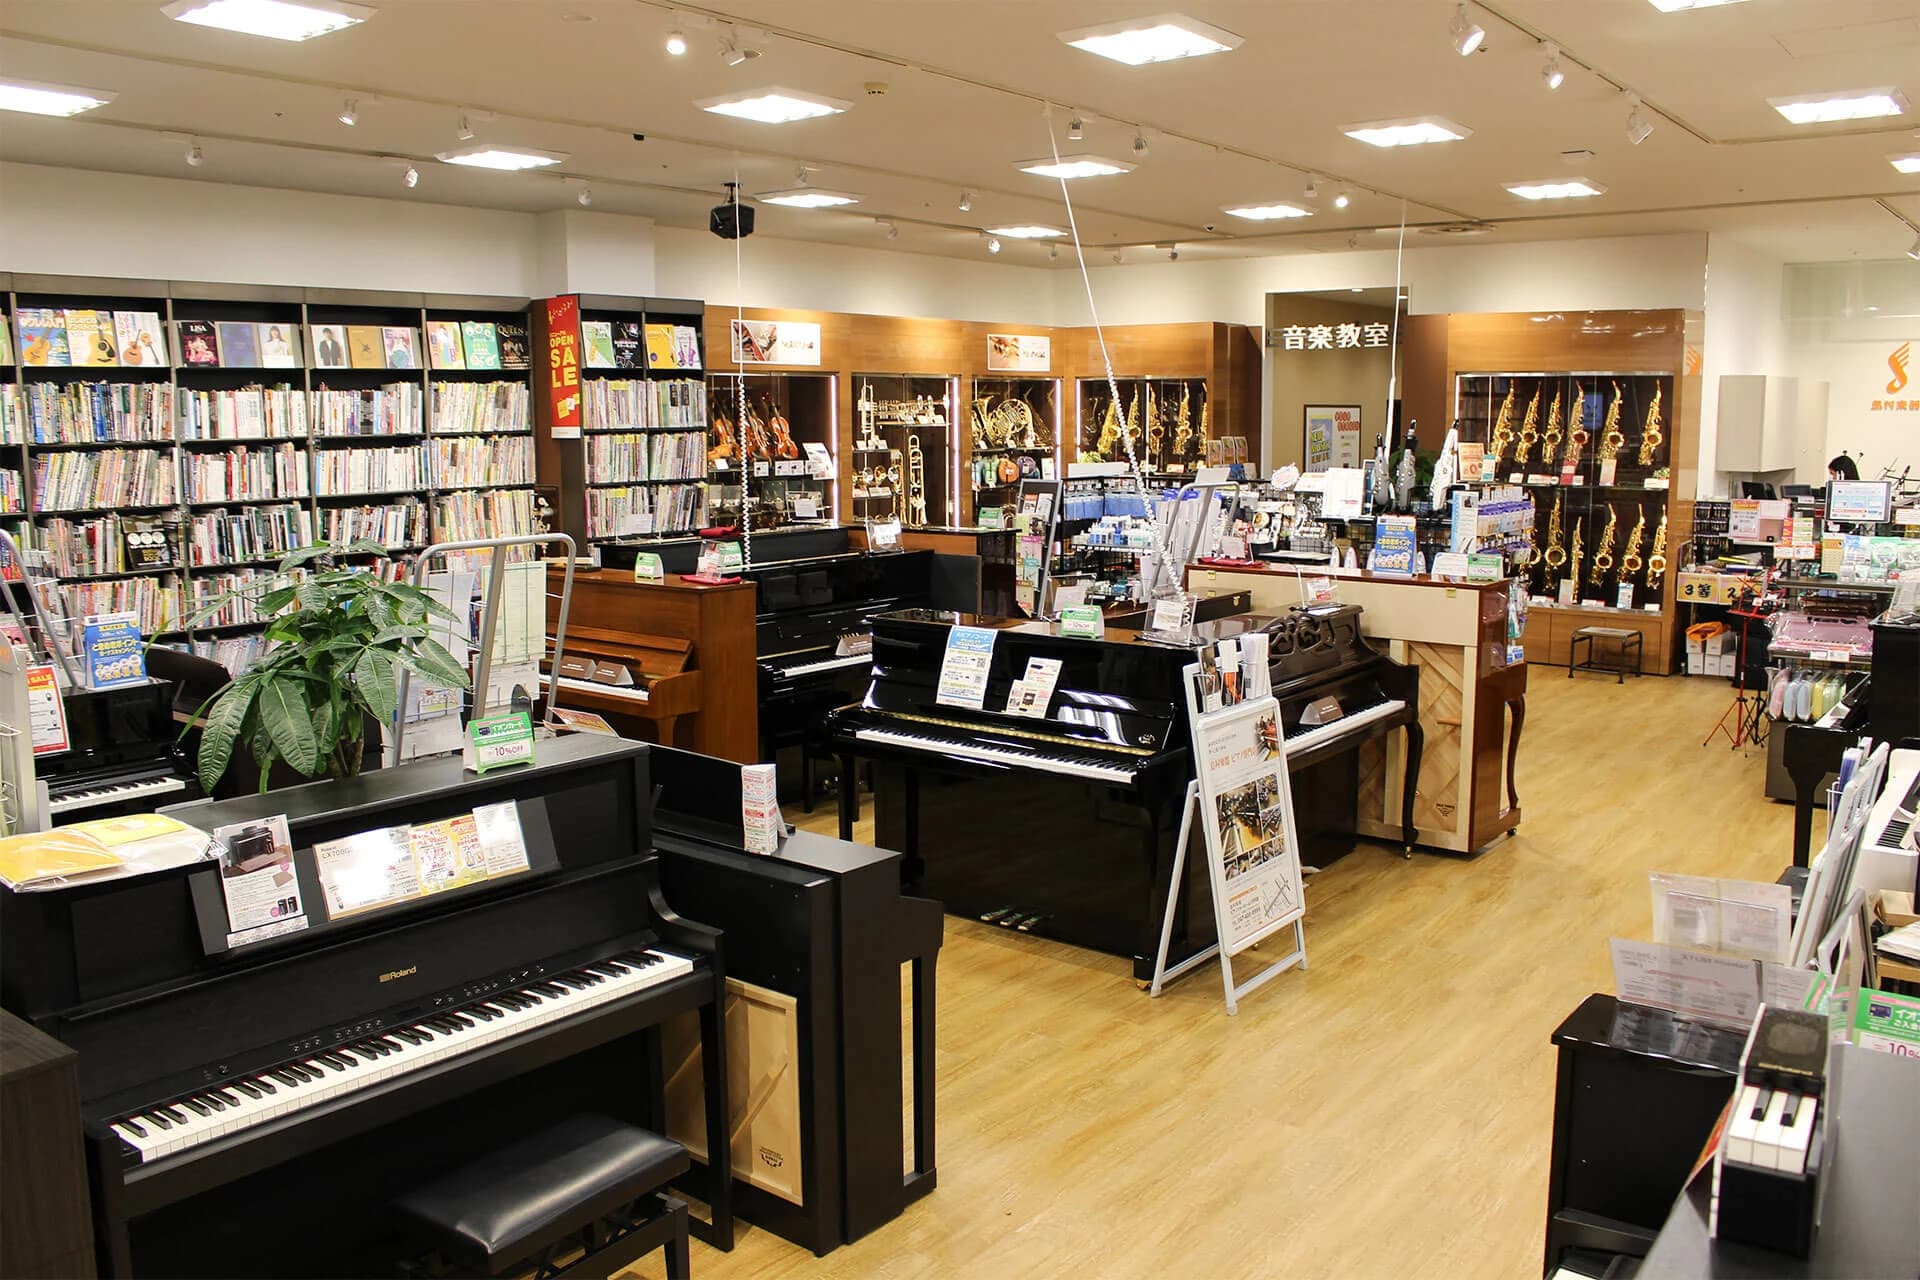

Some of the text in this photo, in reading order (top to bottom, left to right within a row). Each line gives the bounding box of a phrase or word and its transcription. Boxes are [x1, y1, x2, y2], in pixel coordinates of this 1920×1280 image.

[550, 334, 574, 348] OPEN
[1283, 322, 1389, 350] 音楽教室
[390, 965, 417, 980] Roland
